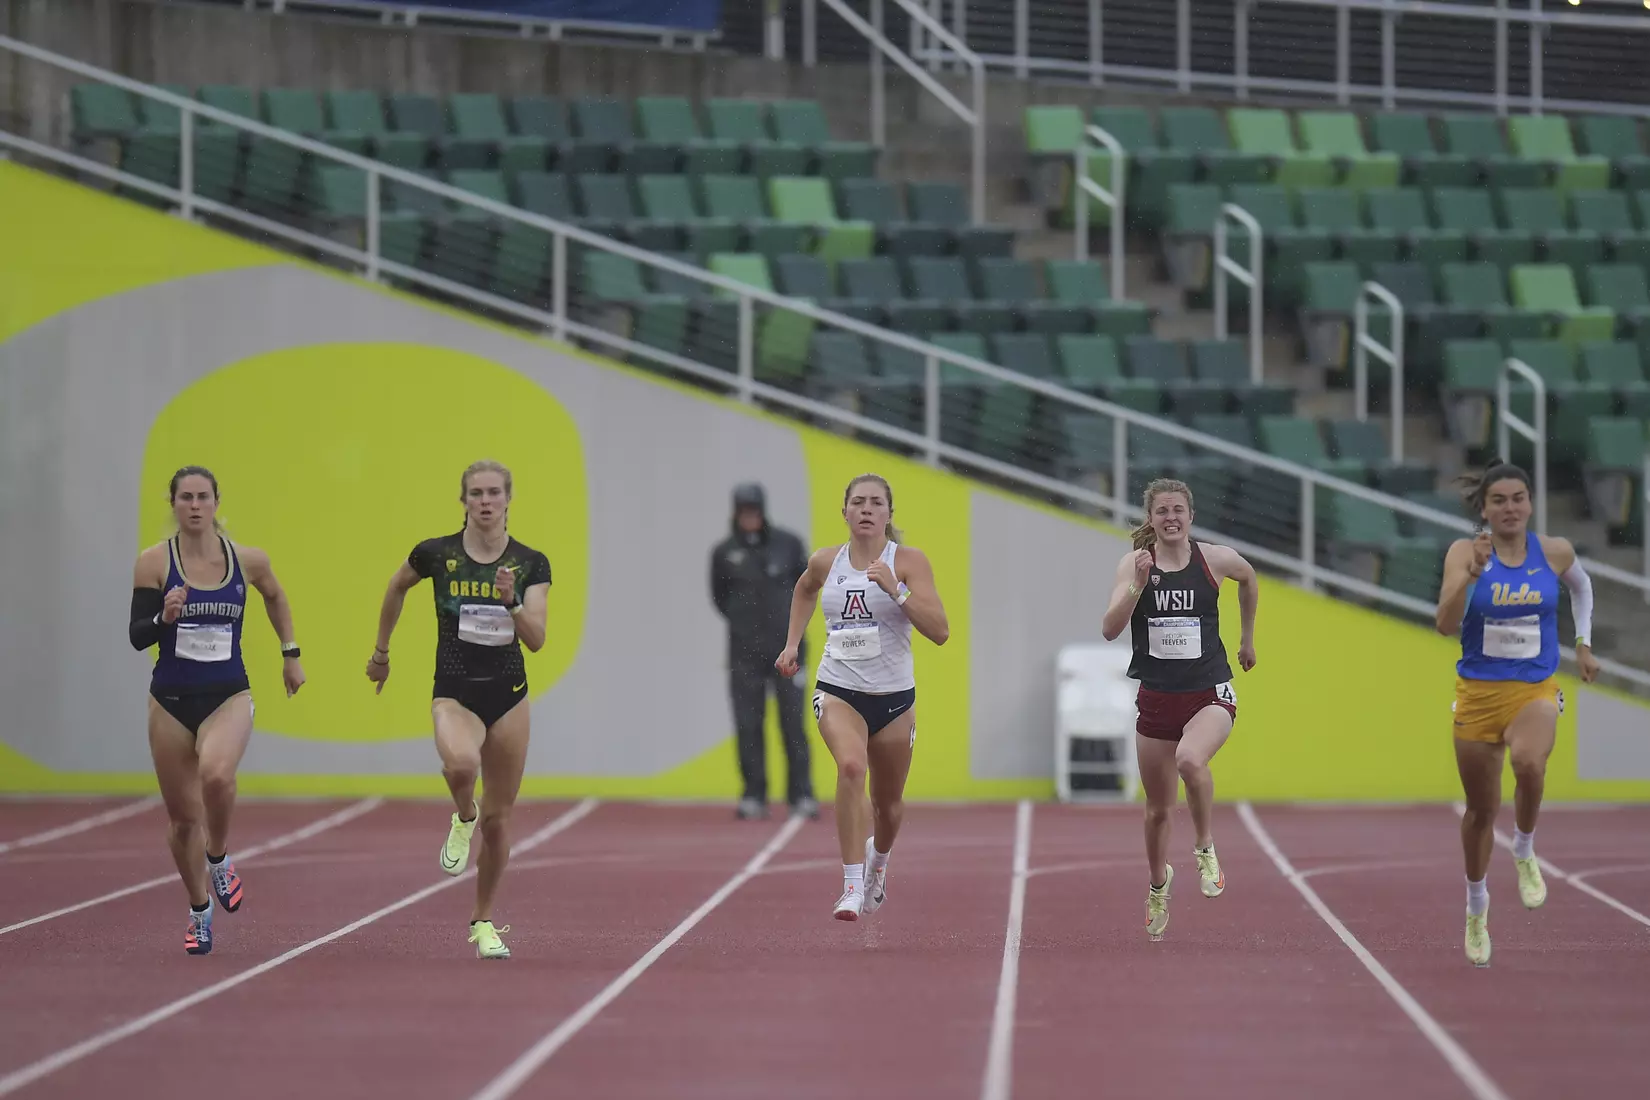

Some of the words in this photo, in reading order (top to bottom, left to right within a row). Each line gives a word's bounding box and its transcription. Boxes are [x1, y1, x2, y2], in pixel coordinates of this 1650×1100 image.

[841, 590, 873, 620] A
[1154, 590, 1195, 611] WSU
[181, 602, 243, 619] ASHINGTON
[841, 639, 866, 648] POWERS
[1162, 638, 1187, 646] TEEVENS
[1222, 684, 1233, 703] 4
